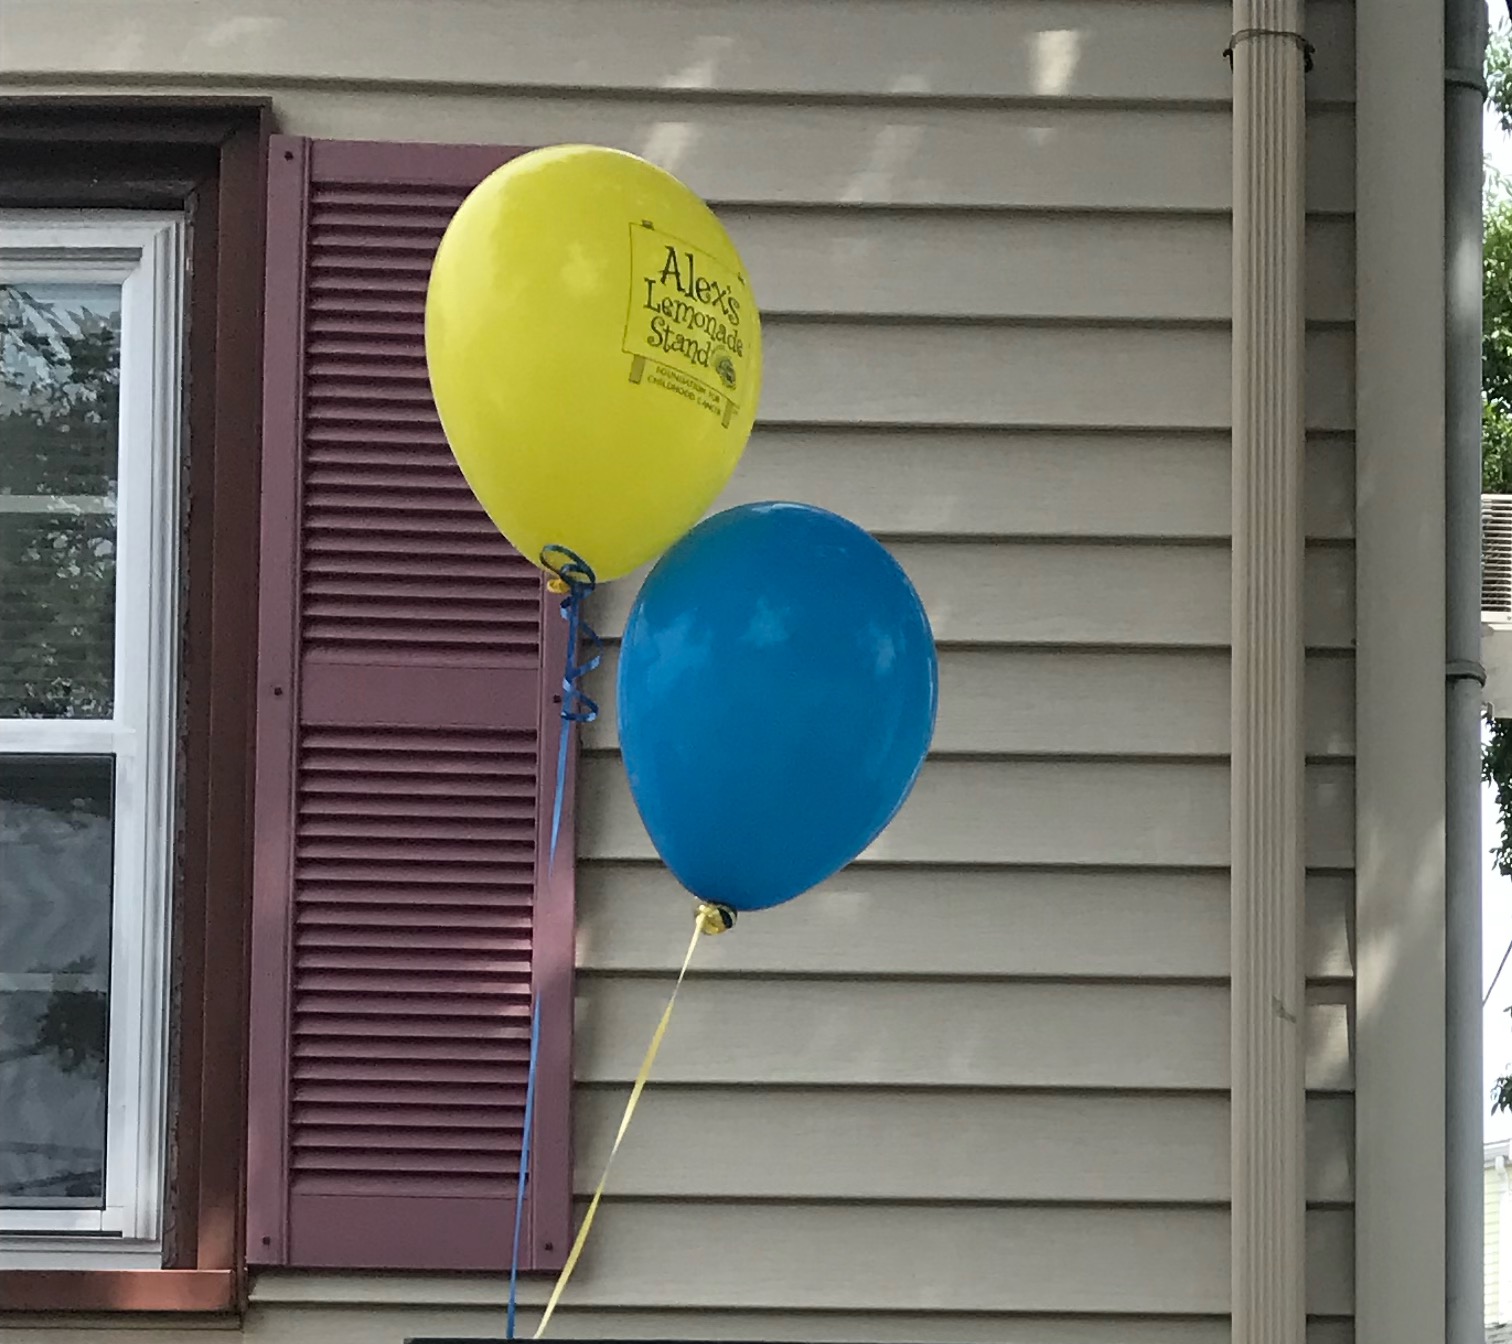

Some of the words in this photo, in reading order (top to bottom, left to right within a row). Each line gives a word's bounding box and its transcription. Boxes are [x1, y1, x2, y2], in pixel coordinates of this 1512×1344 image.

[643, 277, 743, 357] Lemonade
[659, 245, 740, 326] Alex's
[647, 315, 711, 368] Stand
